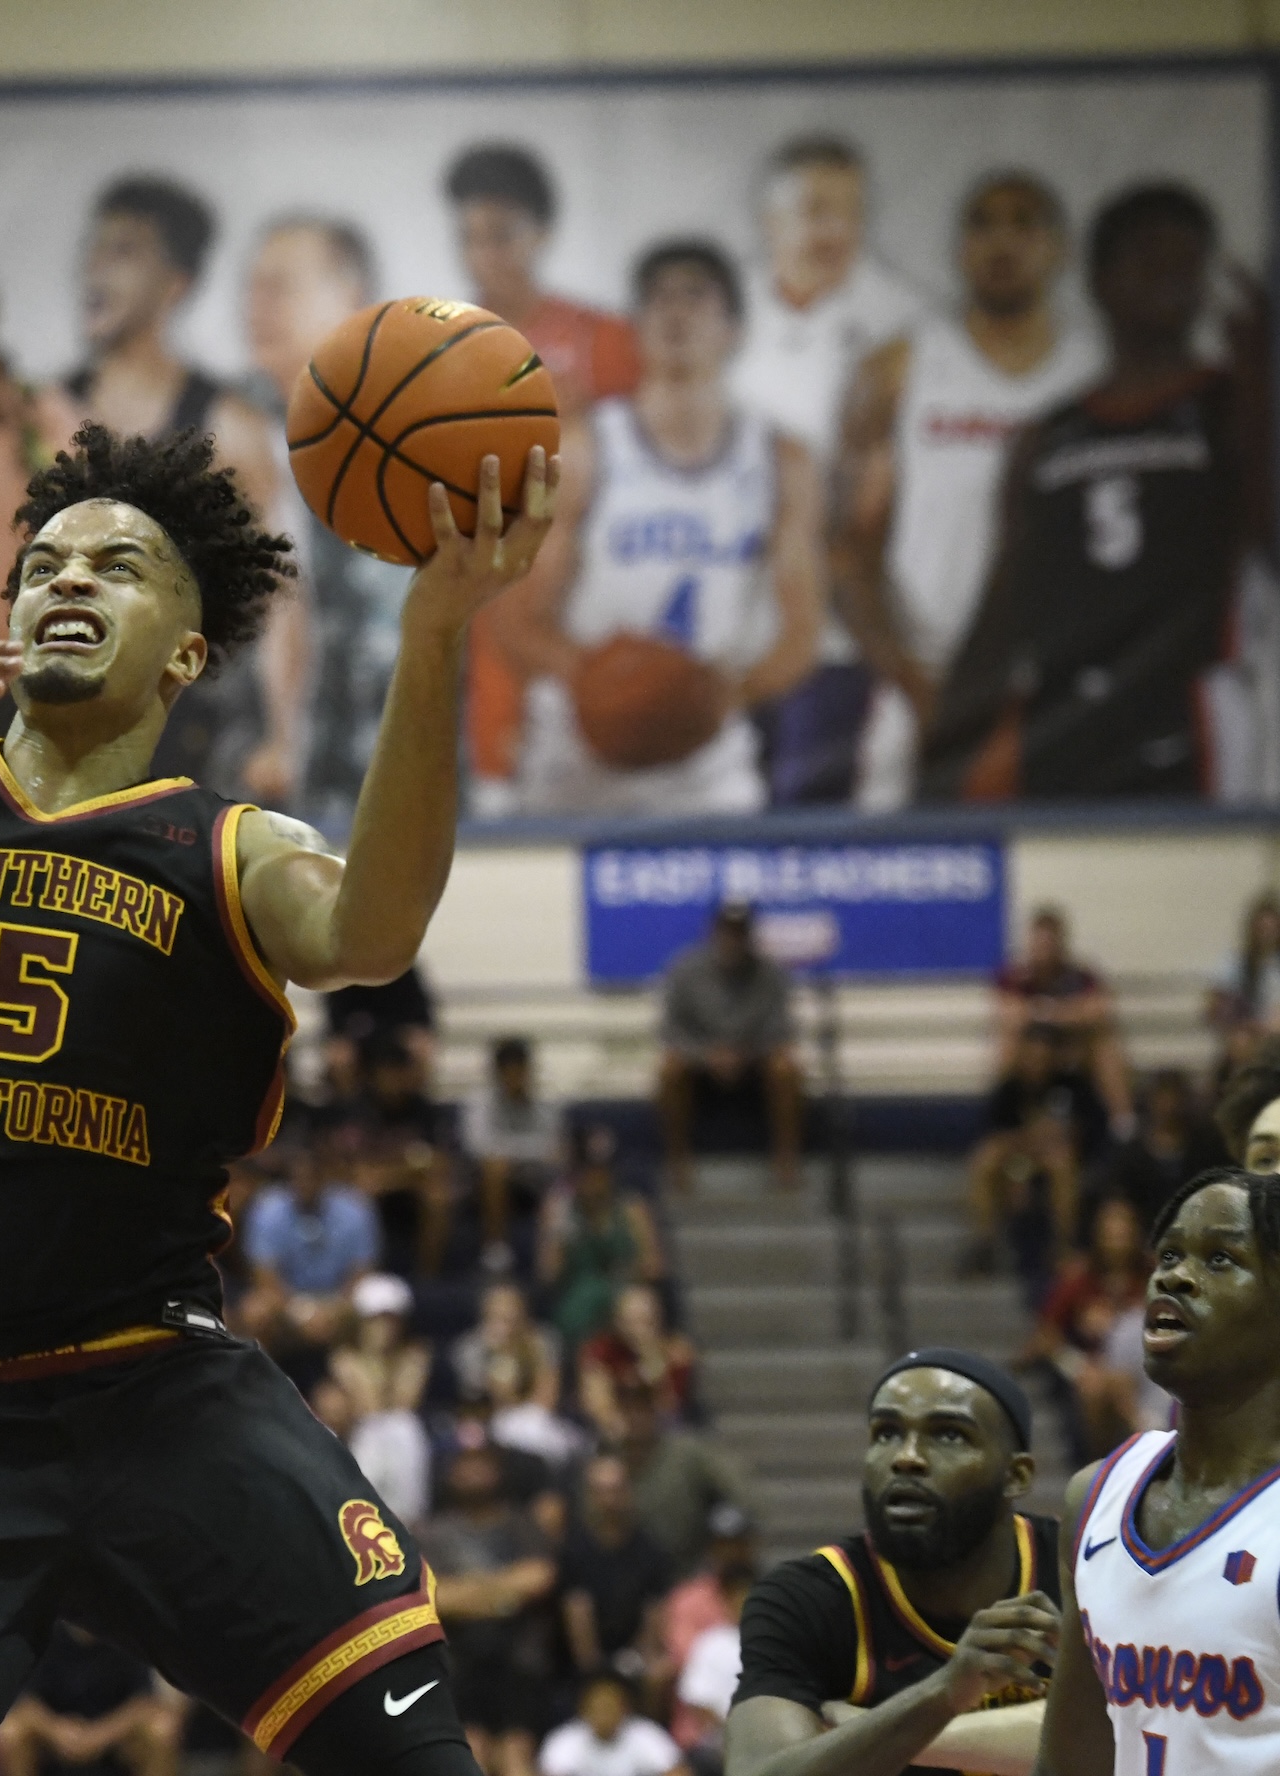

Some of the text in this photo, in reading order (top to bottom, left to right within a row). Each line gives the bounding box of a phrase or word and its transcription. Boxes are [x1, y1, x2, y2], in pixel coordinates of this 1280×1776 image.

[1084, 476, 1143, 570] 5
[593, 846, 994, 906] EAST BLEACHERS
